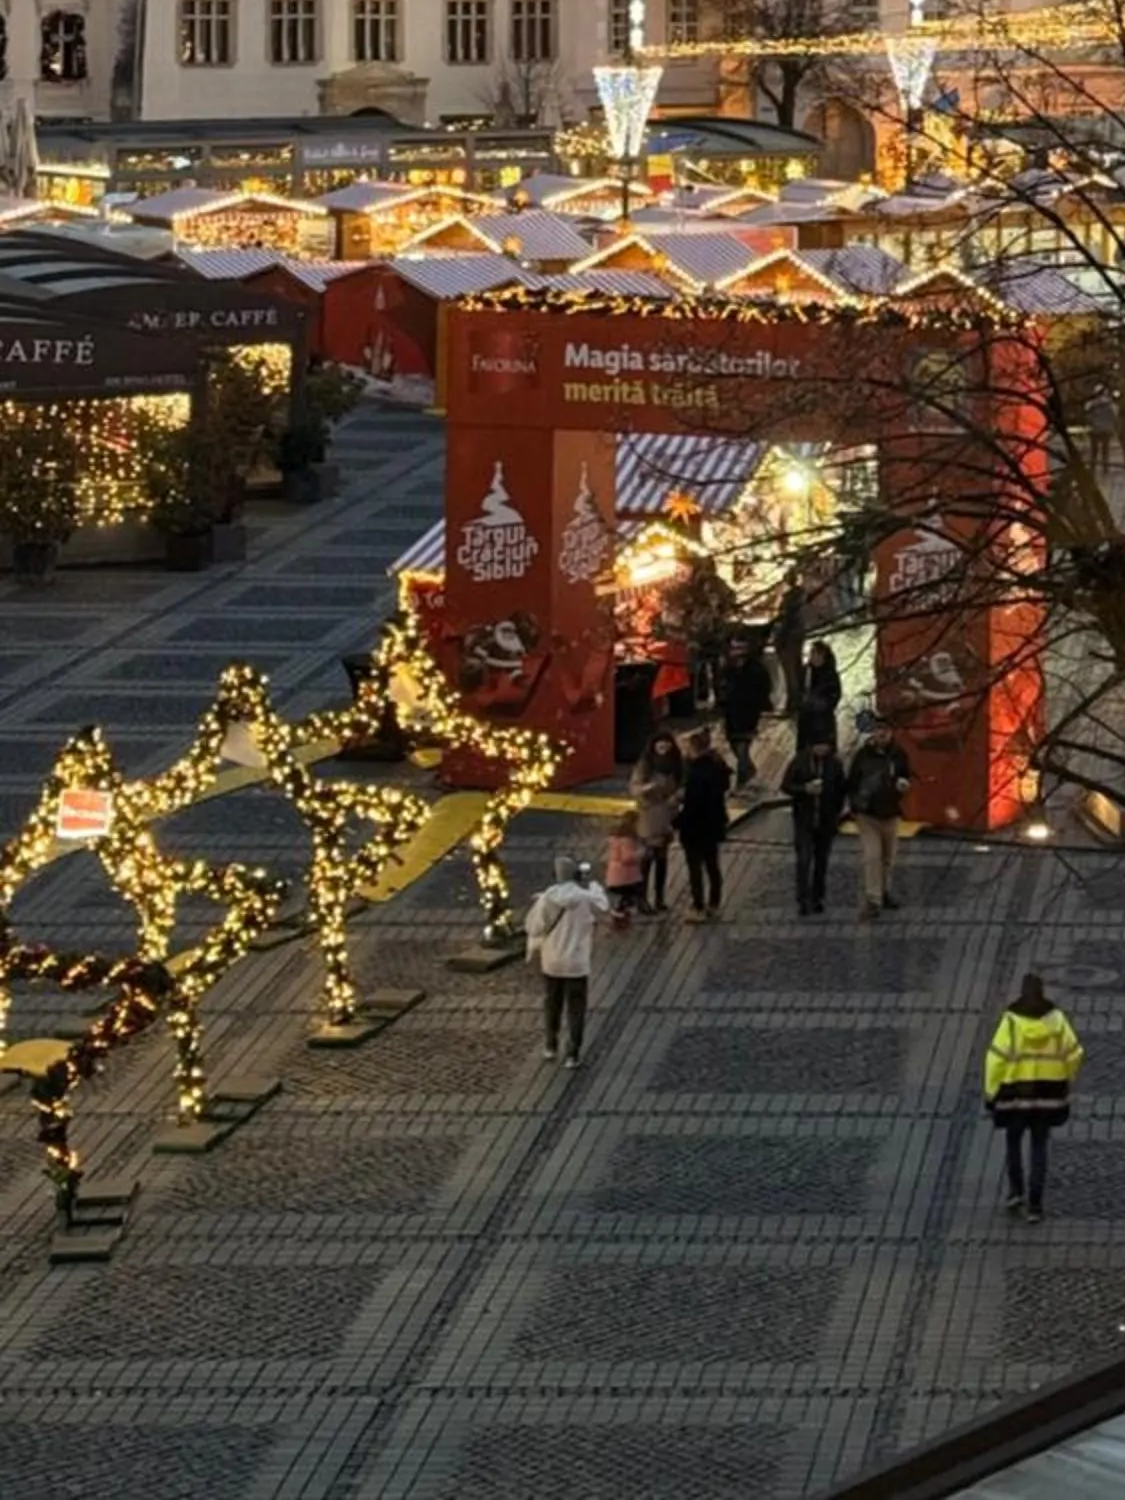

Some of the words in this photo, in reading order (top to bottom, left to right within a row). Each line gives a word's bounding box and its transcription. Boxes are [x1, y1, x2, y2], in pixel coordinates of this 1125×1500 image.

[210, 305, 279, 328] CAFFÉ
[0, 334, 95, 364] AFFÉ
[564, 343, 644, 376] Magia
[563, 379, 647, 405] merită
